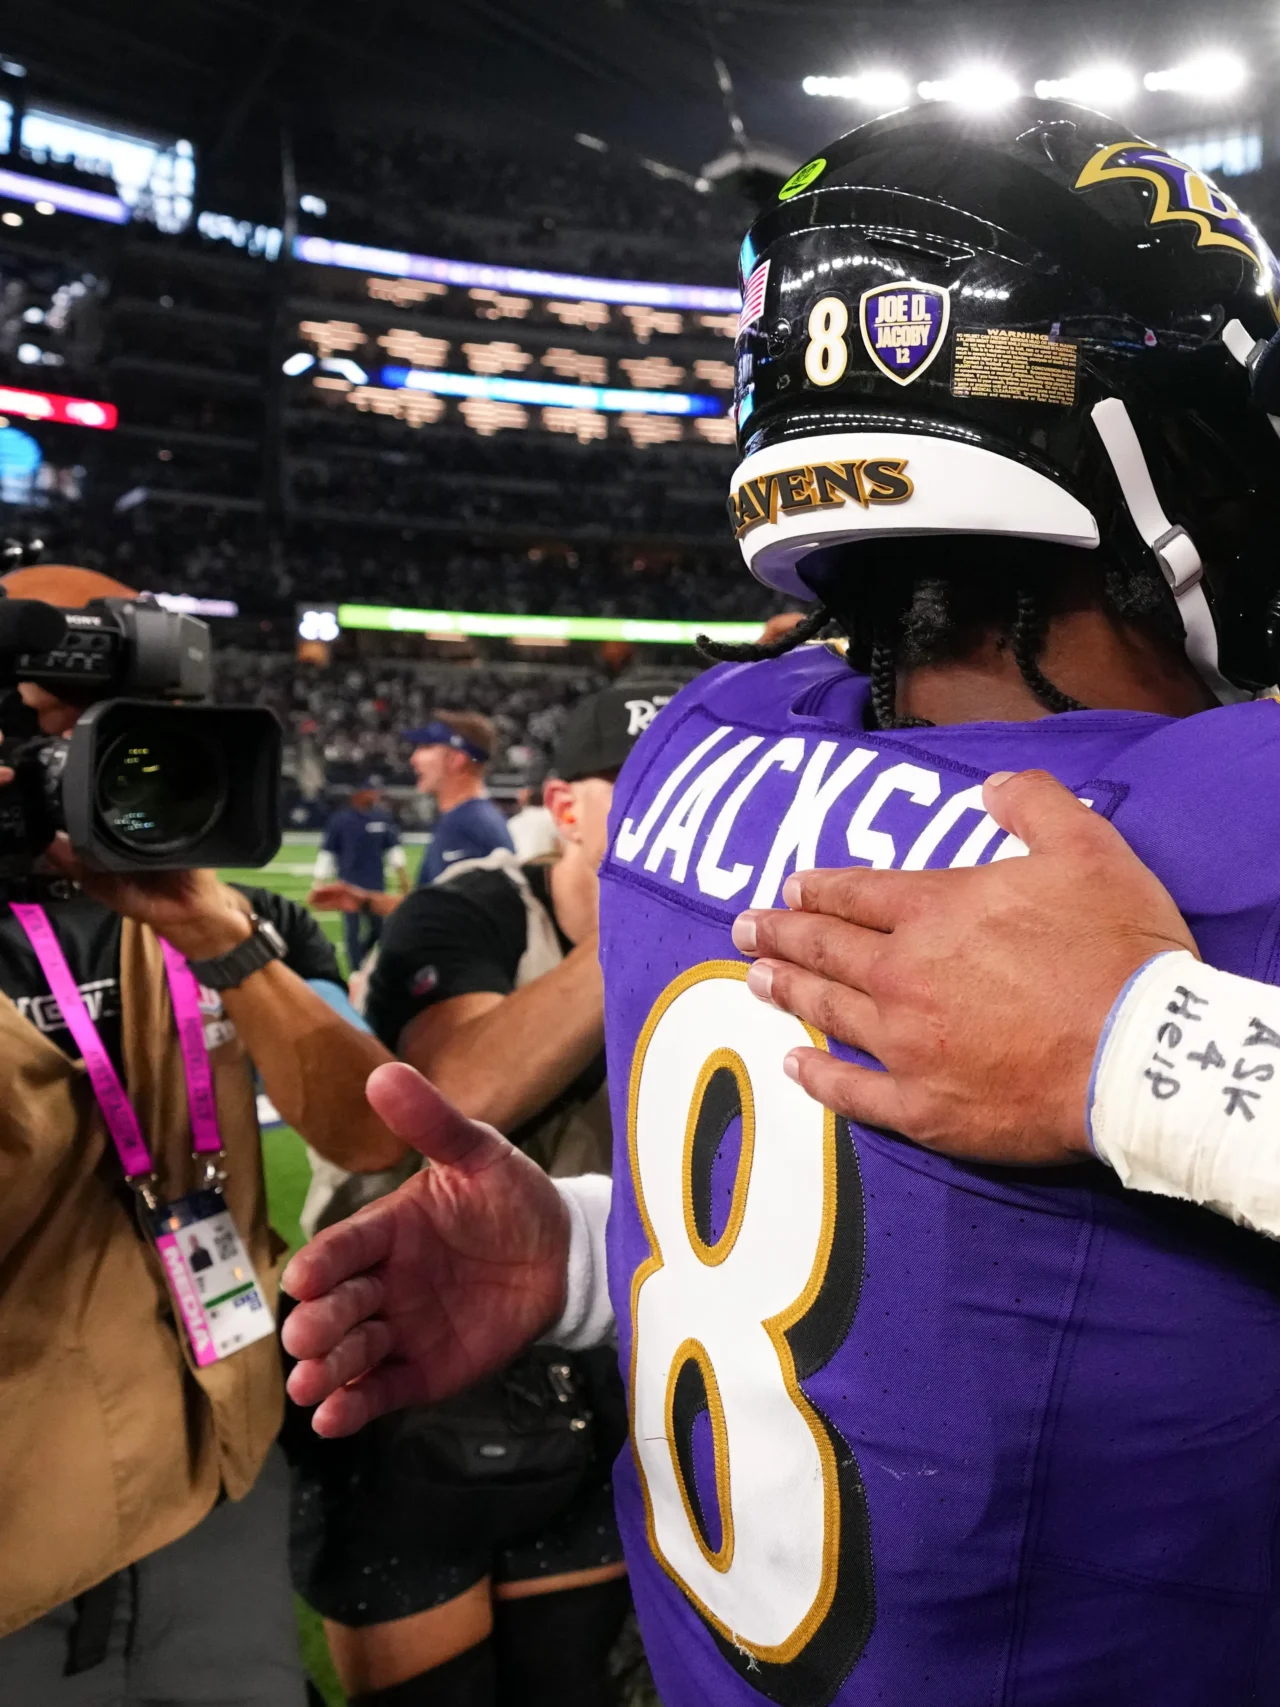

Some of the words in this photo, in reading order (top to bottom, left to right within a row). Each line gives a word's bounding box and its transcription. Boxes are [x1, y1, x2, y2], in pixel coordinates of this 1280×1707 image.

[875, 294, 908, 324] JOE
[911, 294, 931, 321] D.
[804, 296, 849, 387] 8
[875, 324, 931, 349] JACOBY
[987, 329, 1048, 341] WARNING
[895, 347, 911, 364] 12
[615, 726, 1093, 910] JACKSO
[1186, 1039, 1226, 1071] 4
[628, 958, 866, 1694] 8
